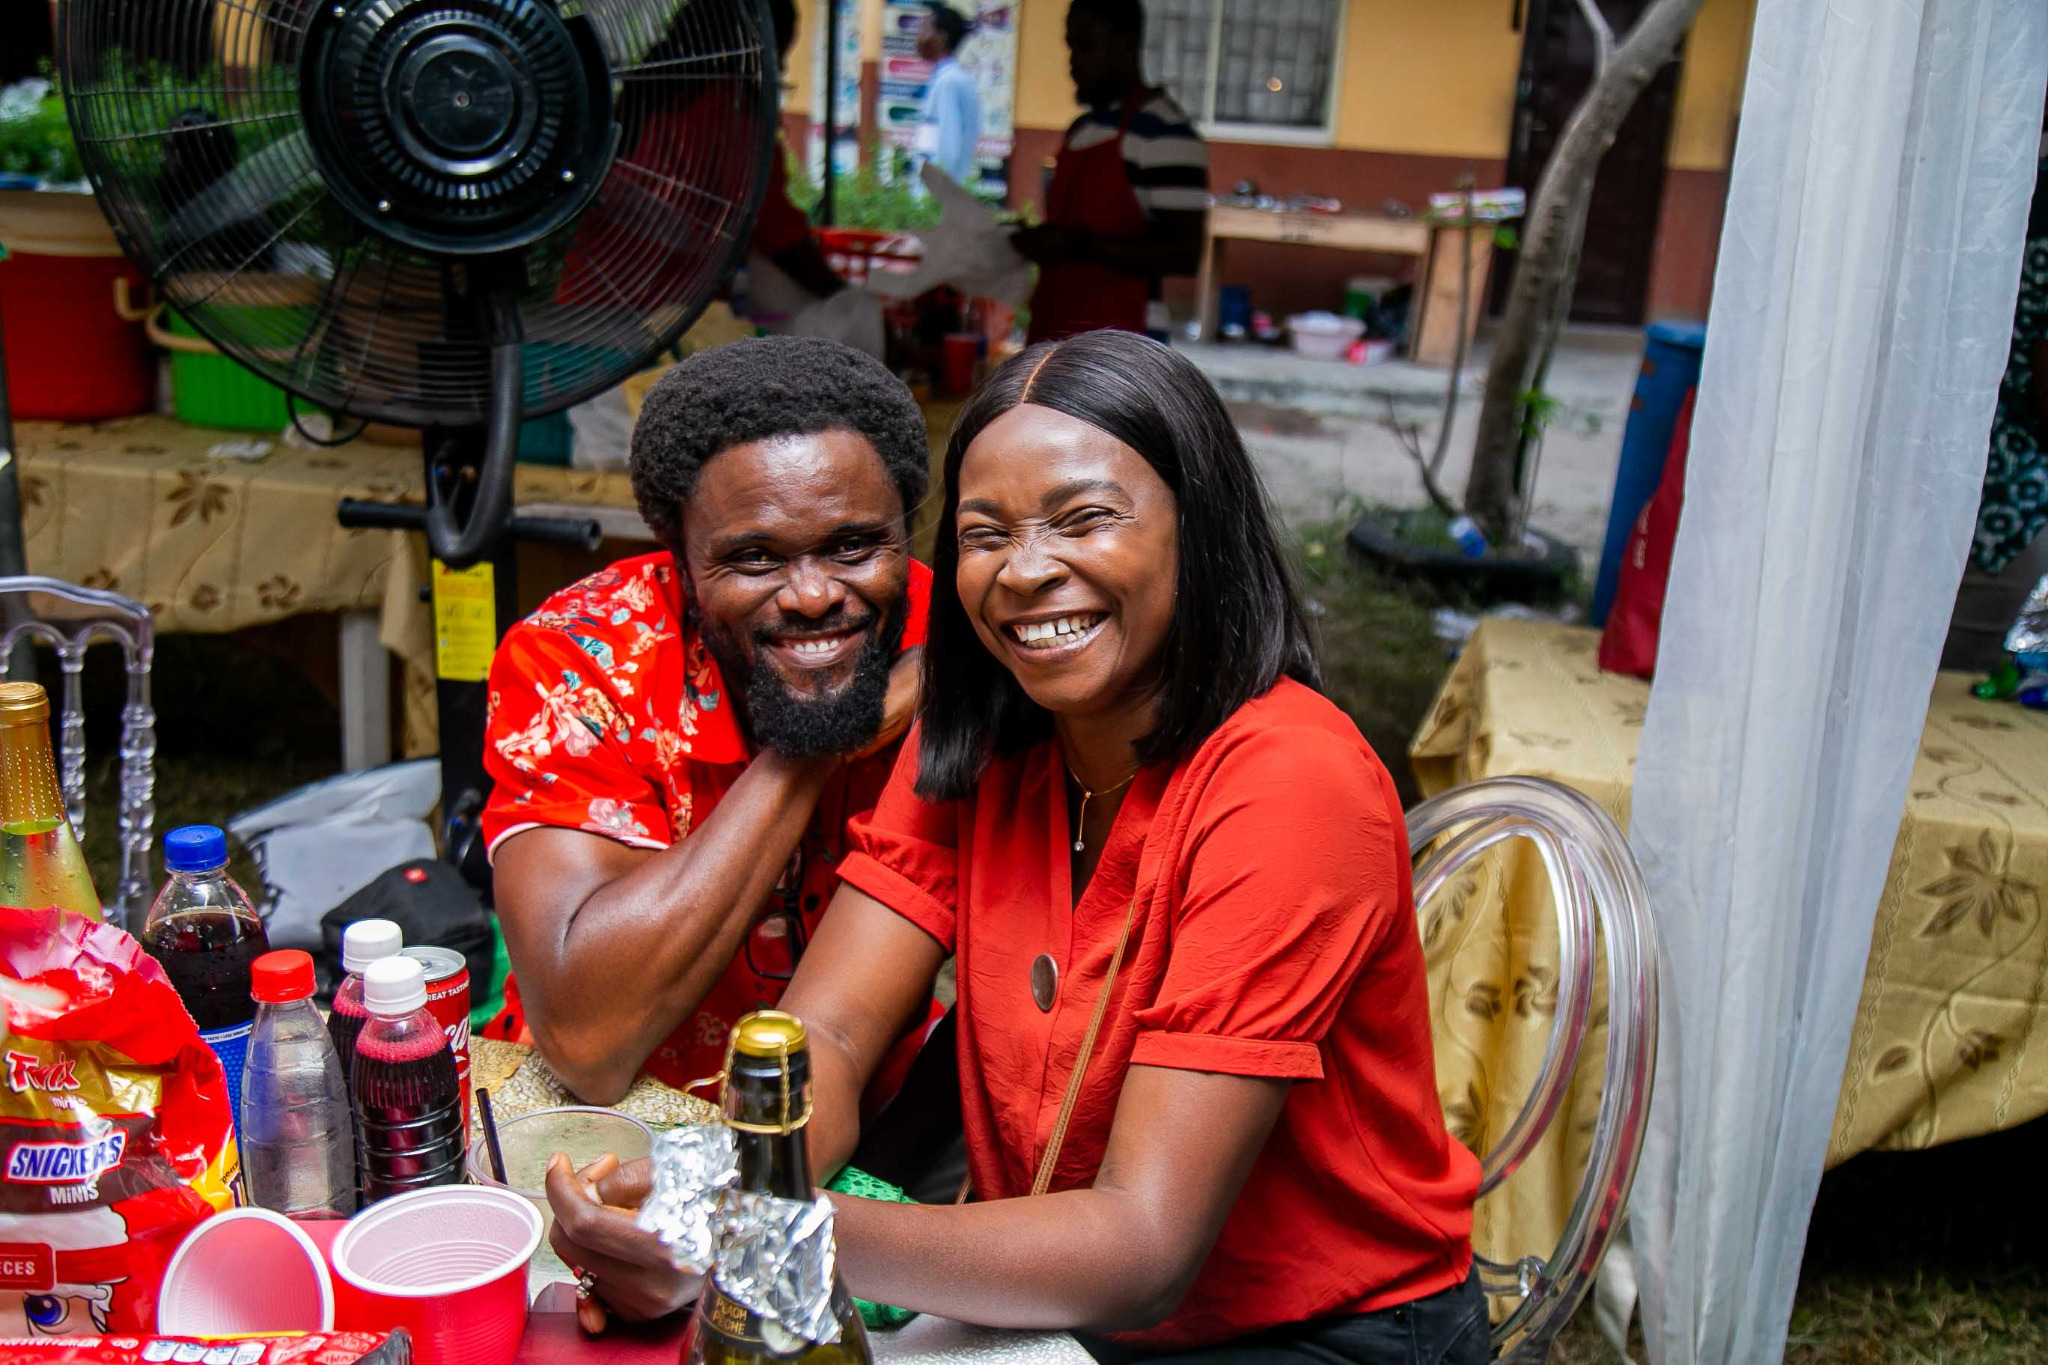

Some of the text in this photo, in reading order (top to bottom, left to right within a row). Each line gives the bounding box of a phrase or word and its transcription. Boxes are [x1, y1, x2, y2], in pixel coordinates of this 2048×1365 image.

[6, 1051, 81, 1092] Twix
[11, 1136, 122, 1178] SNICKERS
[0, 1261, 35, 1276] CES
